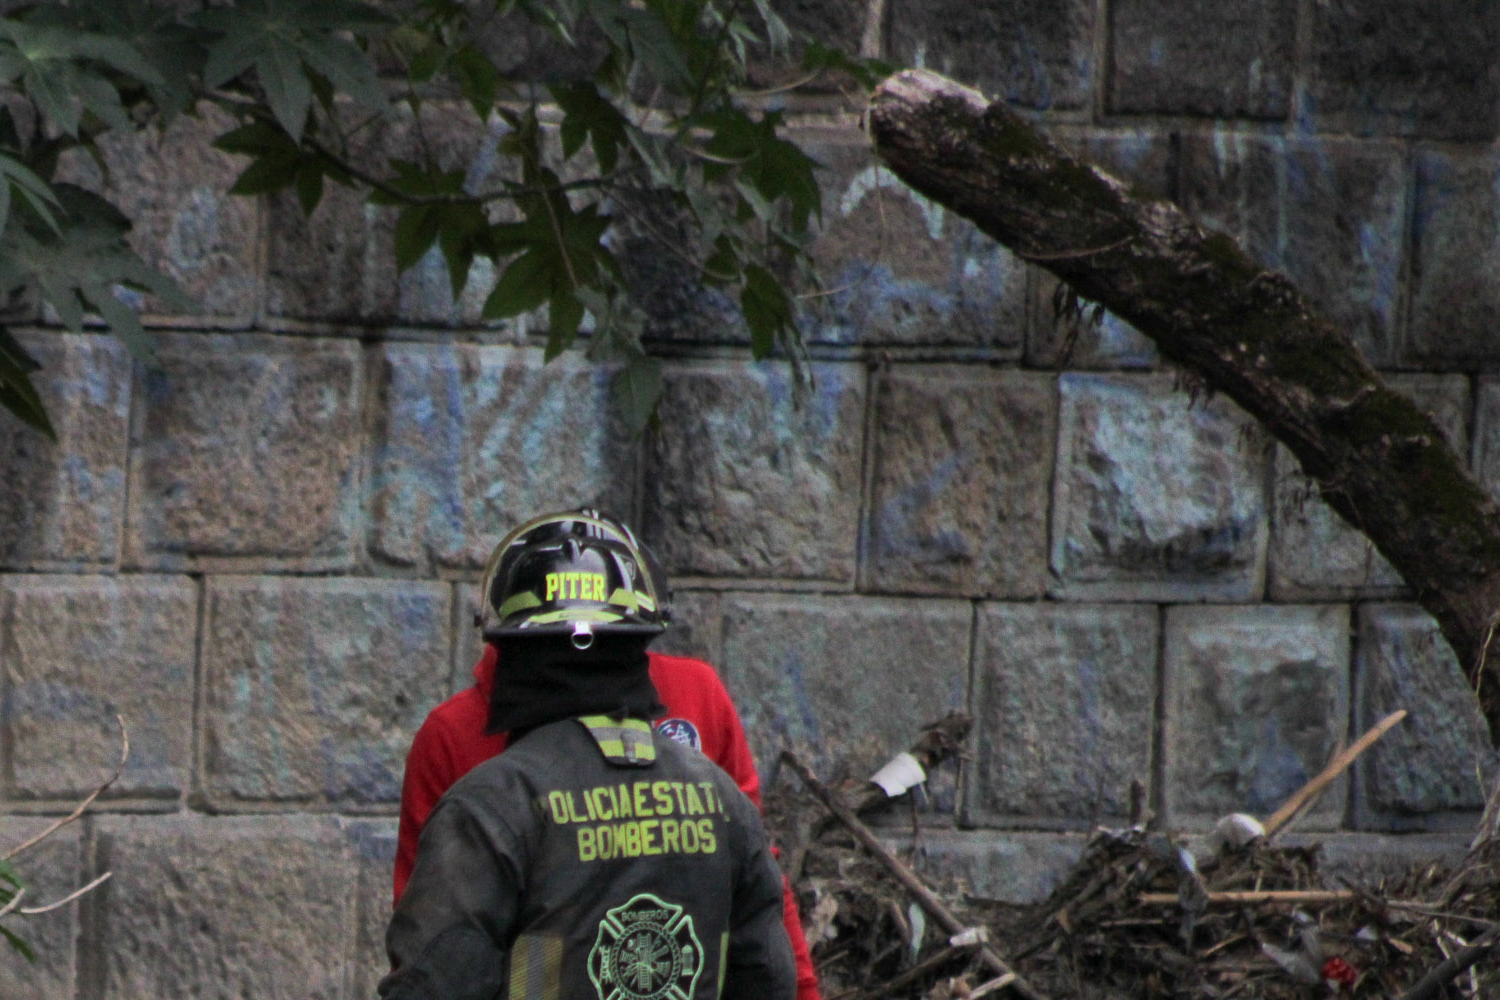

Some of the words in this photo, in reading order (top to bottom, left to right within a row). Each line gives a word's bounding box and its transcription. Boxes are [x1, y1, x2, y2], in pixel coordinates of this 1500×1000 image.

[545, 571, 607, 602] PITER
[576, 818, 718, 862] BOMBEROS
[621, 909, 669, 922] BOMBEROS
